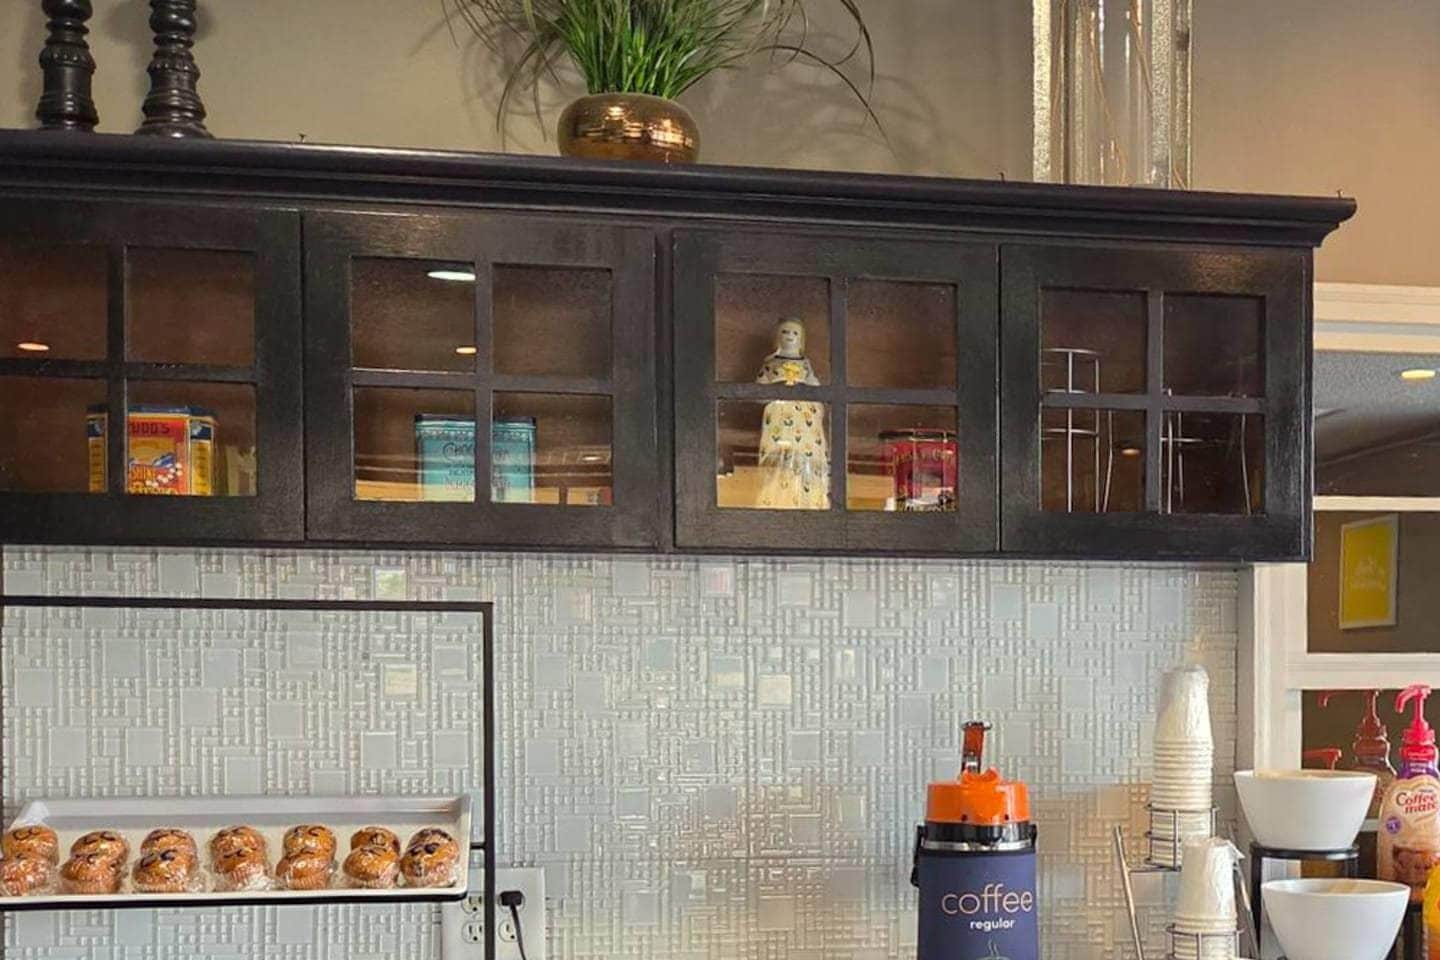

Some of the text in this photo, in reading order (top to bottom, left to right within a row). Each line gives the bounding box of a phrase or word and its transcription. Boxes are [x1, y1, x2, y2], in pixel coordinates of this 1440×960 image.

[1395, 791, 1437, 806] Coffee
[1405, 802, 1438, 814] mate
[942, 883, 1033, 914] coffee
[970, 917, 1016, 932] regular
